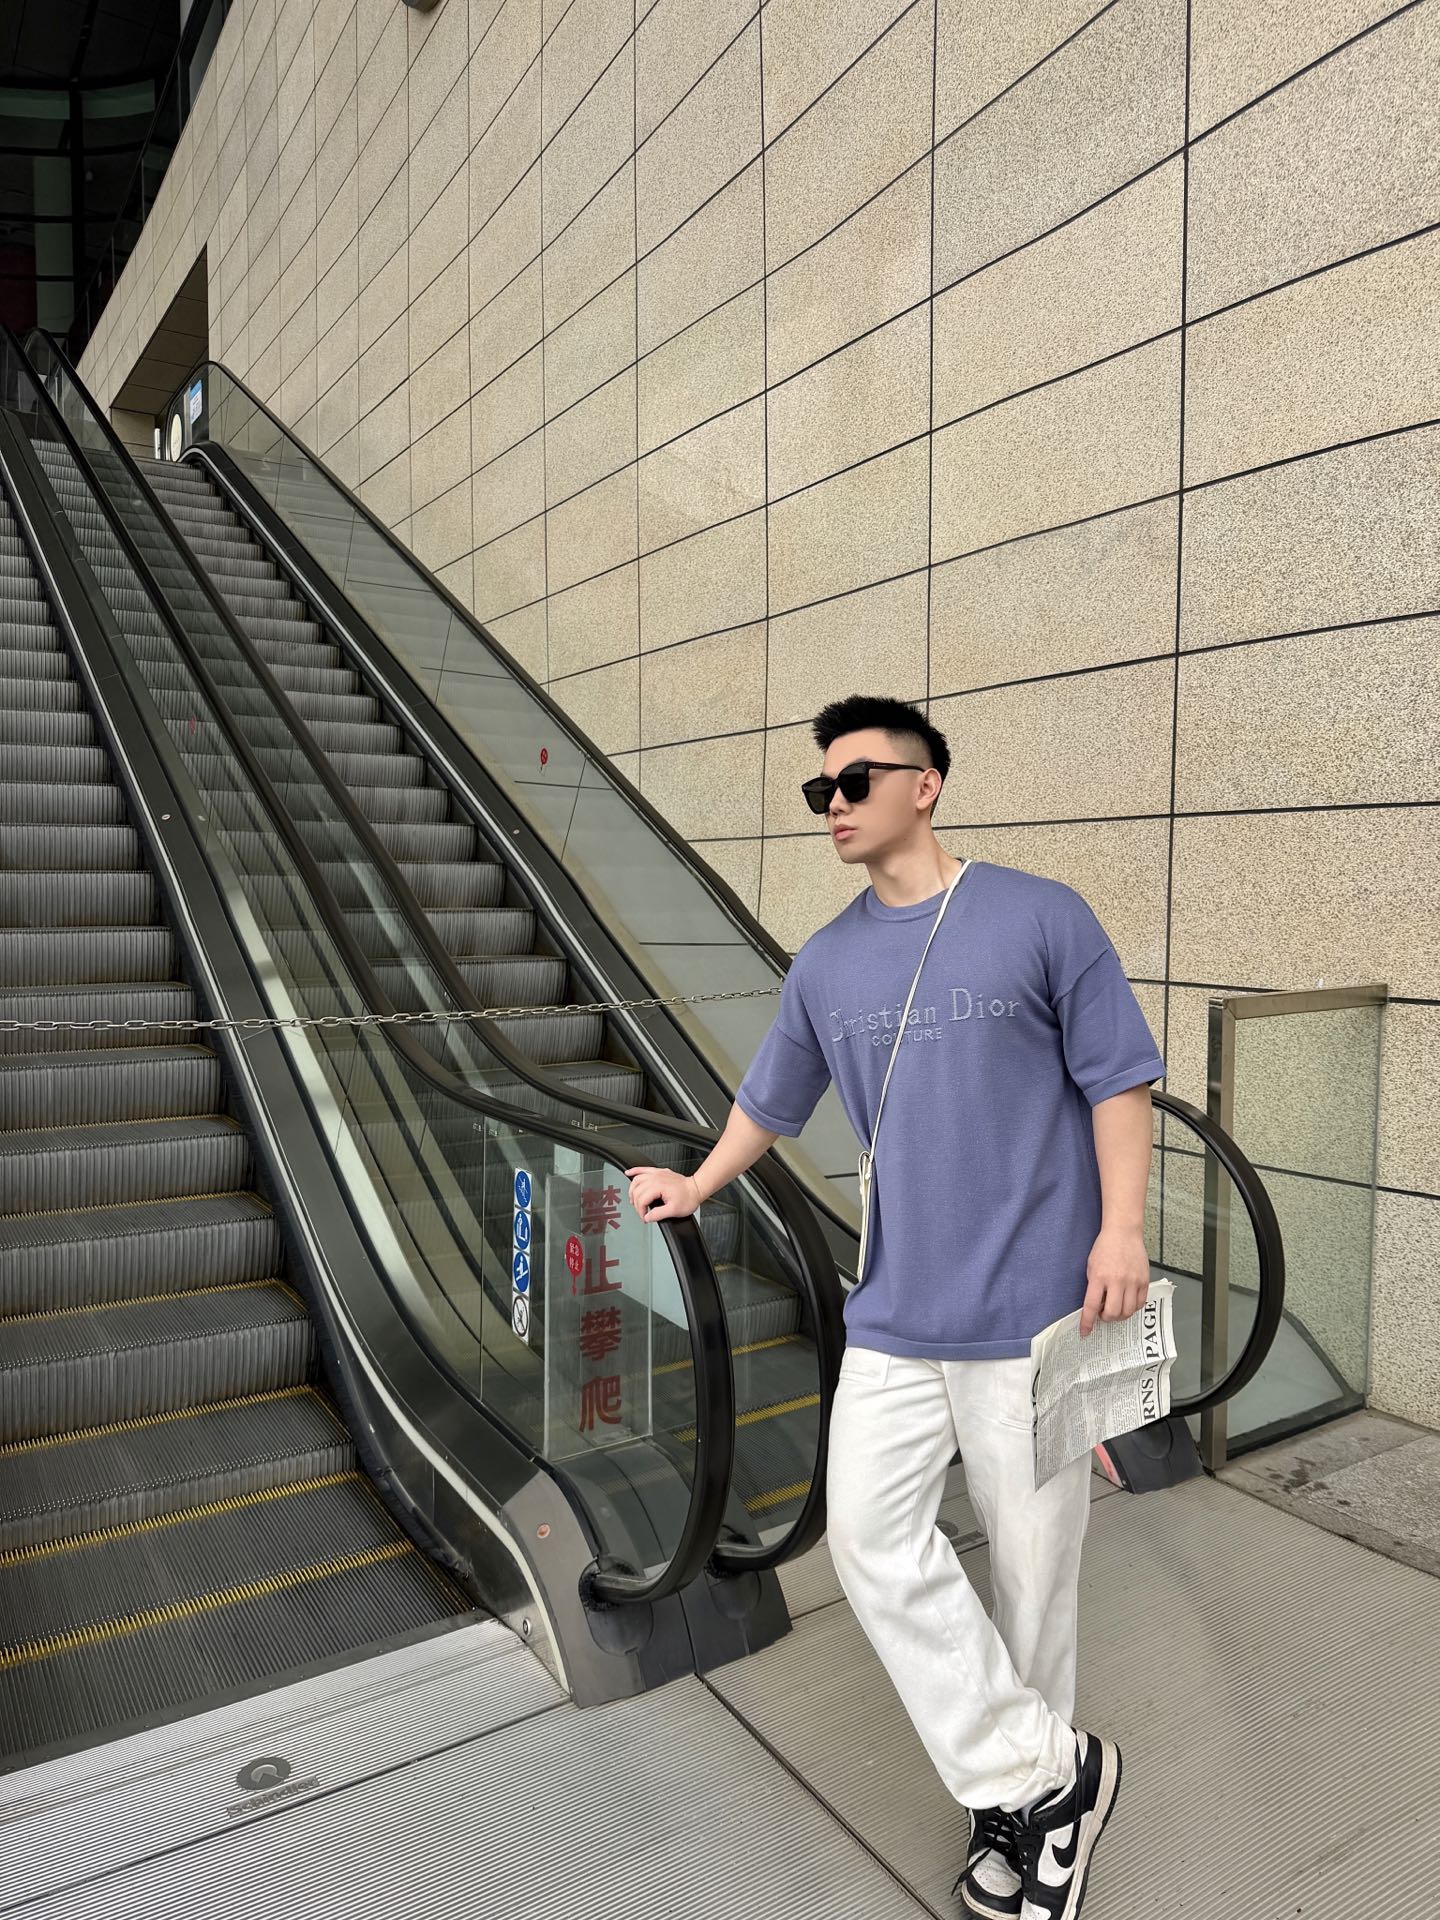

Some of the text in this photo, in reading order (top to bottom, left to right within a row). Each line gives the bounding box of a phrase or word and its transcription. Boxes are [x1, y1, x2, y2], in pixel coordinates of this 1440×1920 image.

[948, 987, 1021, 1021] Dior
[871, 1027, 942, 1046] COTURE
[579, 1185, 623, 1433] 禁止攀爬
[1143, 1300, 1159, 1362] PAGE
[1142, 1378, 1156, 1421] RNS
